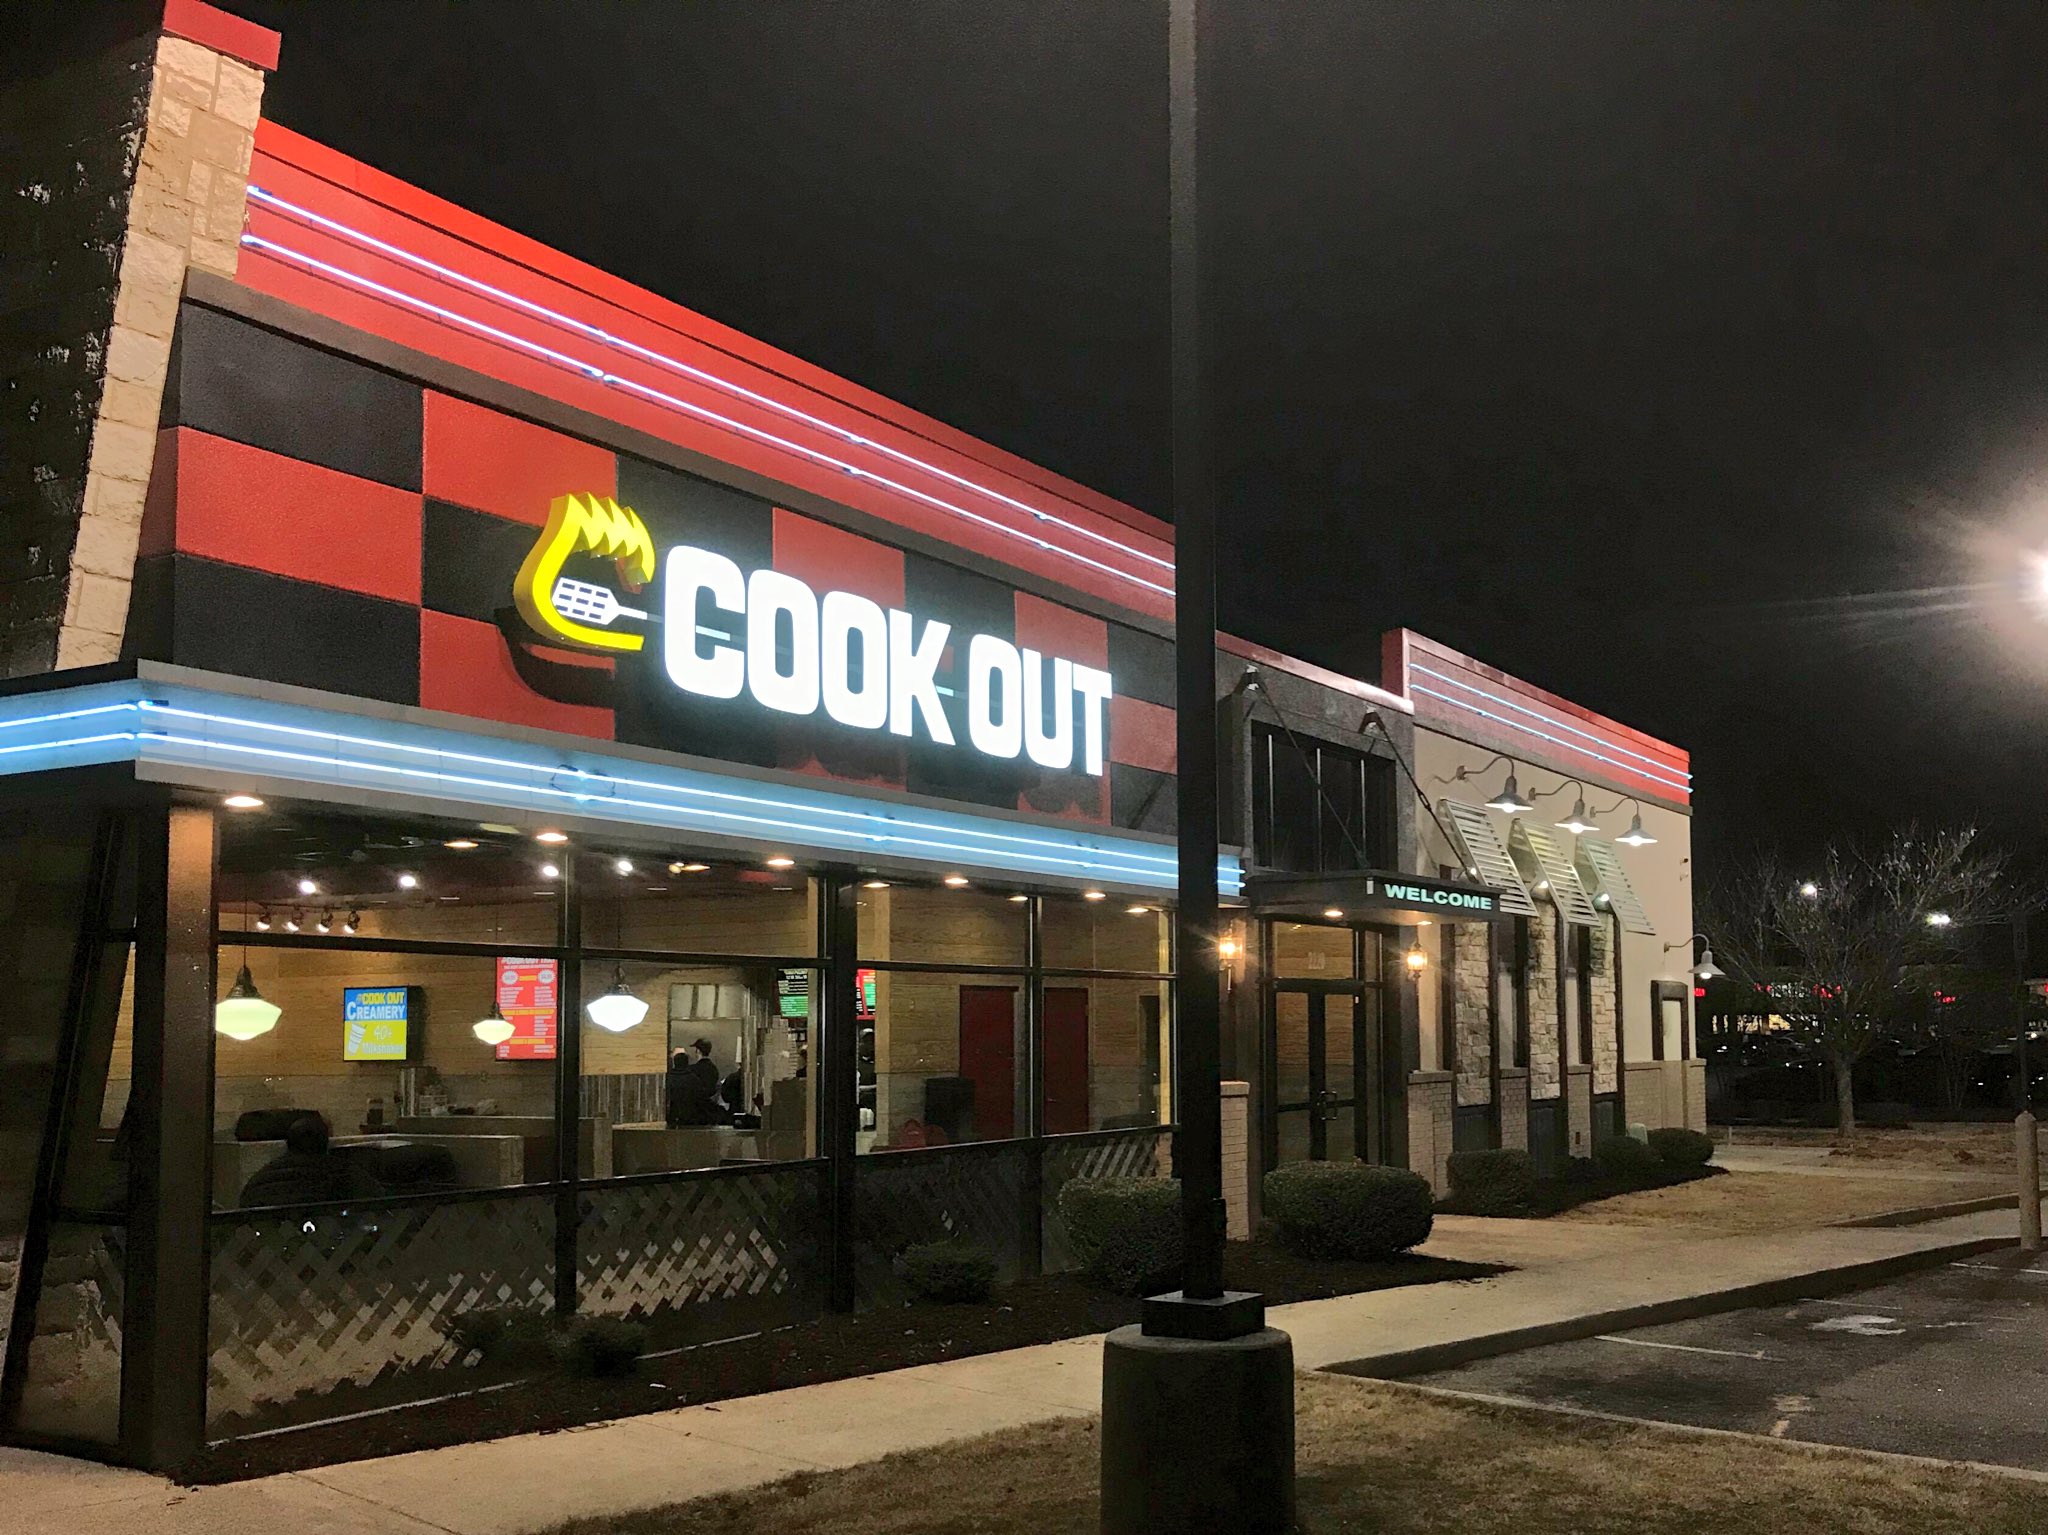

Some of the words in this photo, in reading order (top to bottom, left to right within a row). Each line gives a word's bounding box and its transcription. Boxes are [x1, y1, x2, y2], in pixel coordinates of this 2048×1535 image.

[665, 545, 956, 746] COOK
[968, 634, 1113, 777] OUT
[1384, 883, 1493, 911] WELCOME
[362, 992, 386, 1005] COOK
[387, 991, 404, 1004] OUT
[346, 1001, 405, 1020] CREAMERY
